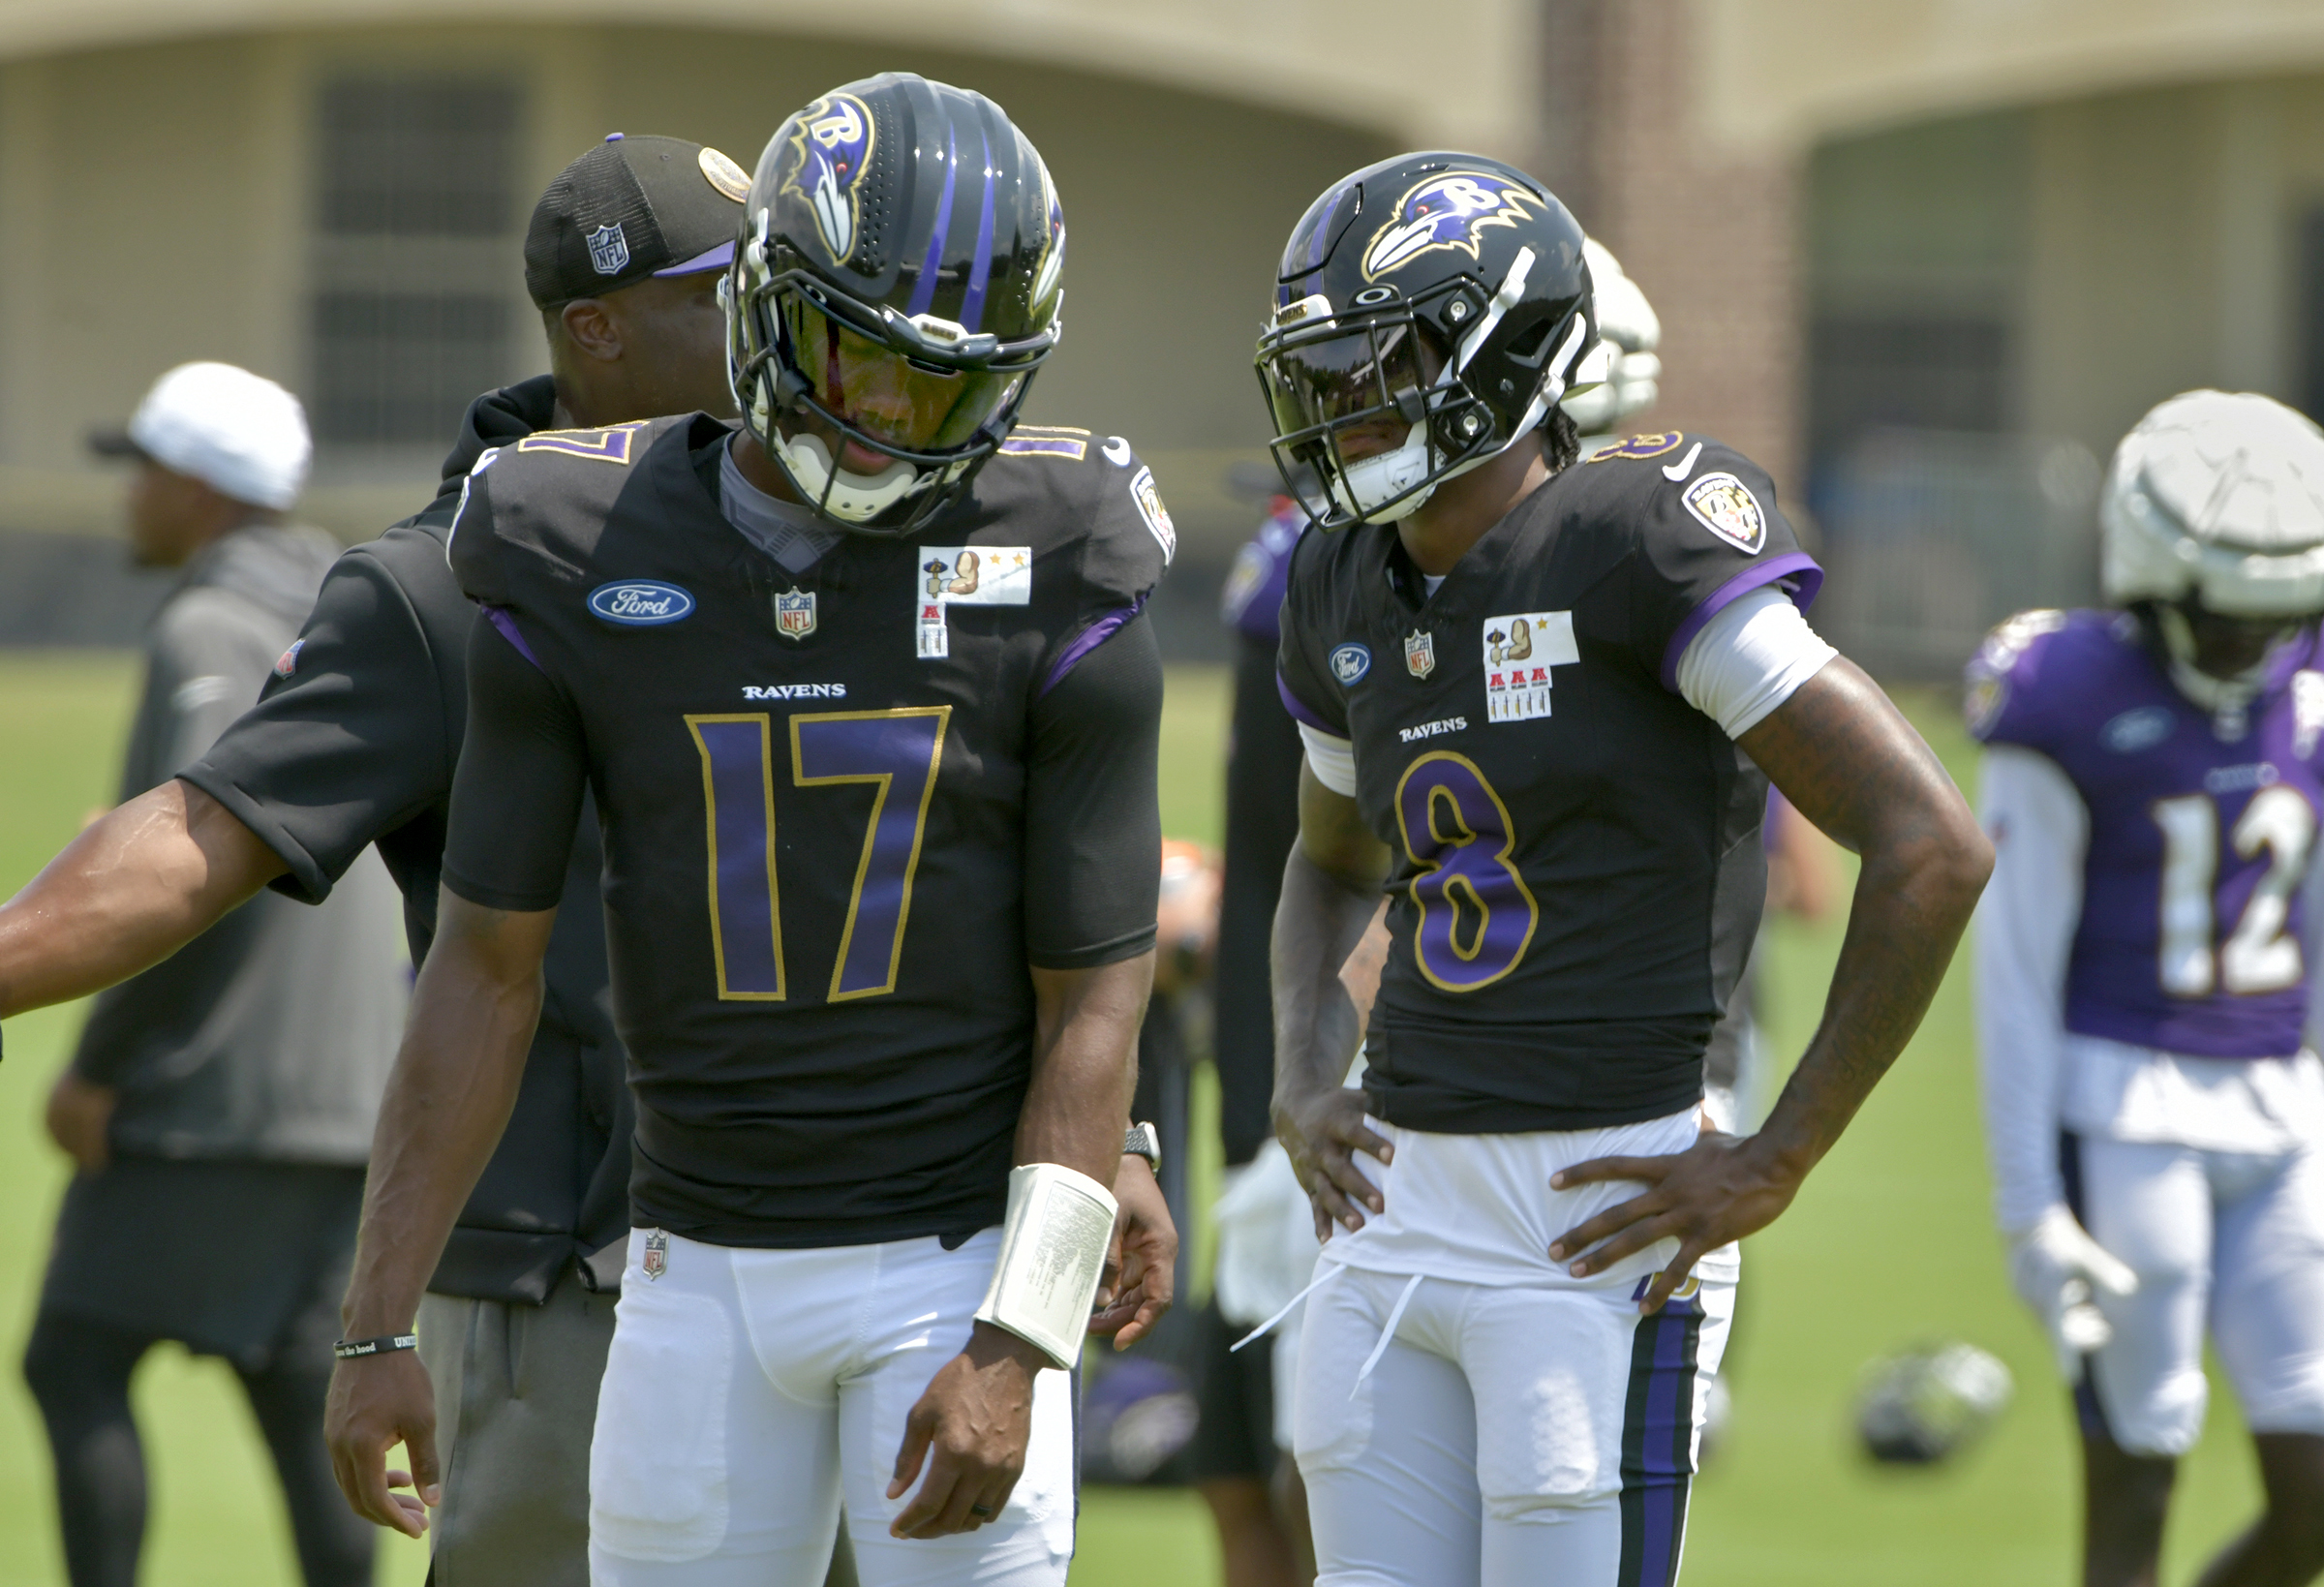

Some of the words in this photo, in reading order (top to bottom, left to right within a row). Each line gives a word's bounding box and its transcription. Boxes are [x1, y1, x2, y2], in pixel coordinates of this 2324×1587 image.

[596, 244, 624, 267] NFL
[611, 588, 672, 615] Ford
[783, 611, 810, 629] NFL
[1336, 652, 1361, 678] Ford
[1410, 652, 1430, 670] NFL
[743, 684, 846, 699] RAVENS
[1399, 717, 1467, 743] RAVENS
[683, 705, 953, 1003] 17
[1394, 750, 1539, 993] 8
[2152, 786, 2316, 997] 12
[355, 1342, 376, 1354] hood
